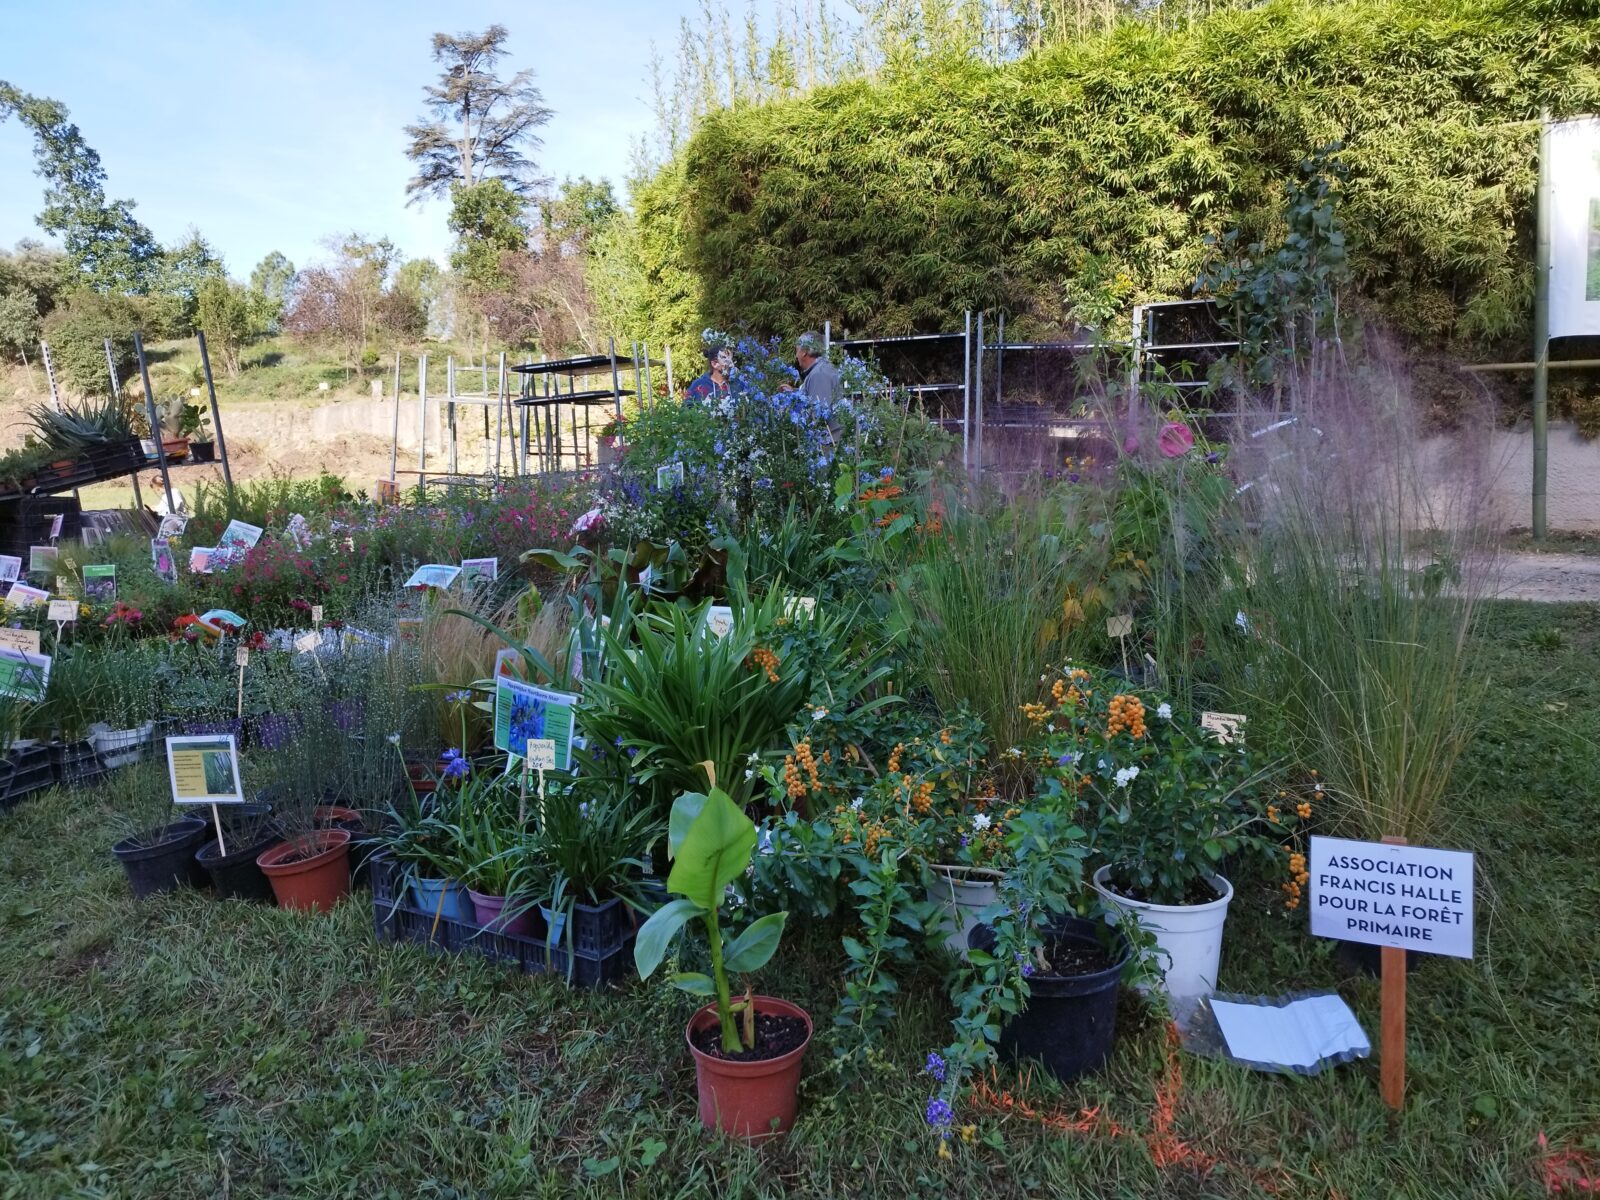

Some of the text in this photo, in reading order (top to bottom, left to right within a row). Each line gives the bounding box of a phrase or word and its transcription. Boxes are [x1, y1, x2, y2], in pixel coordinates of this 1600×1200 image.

[1328, 855, 1453, 881] ASSOCIATION
[1320, 874, 1462, 904] FRANCIS HALLE
[1319, 894, 1464, 925] POUR LA FORÊT
[1347, 918, 1433, 941] PRIMAIRE
